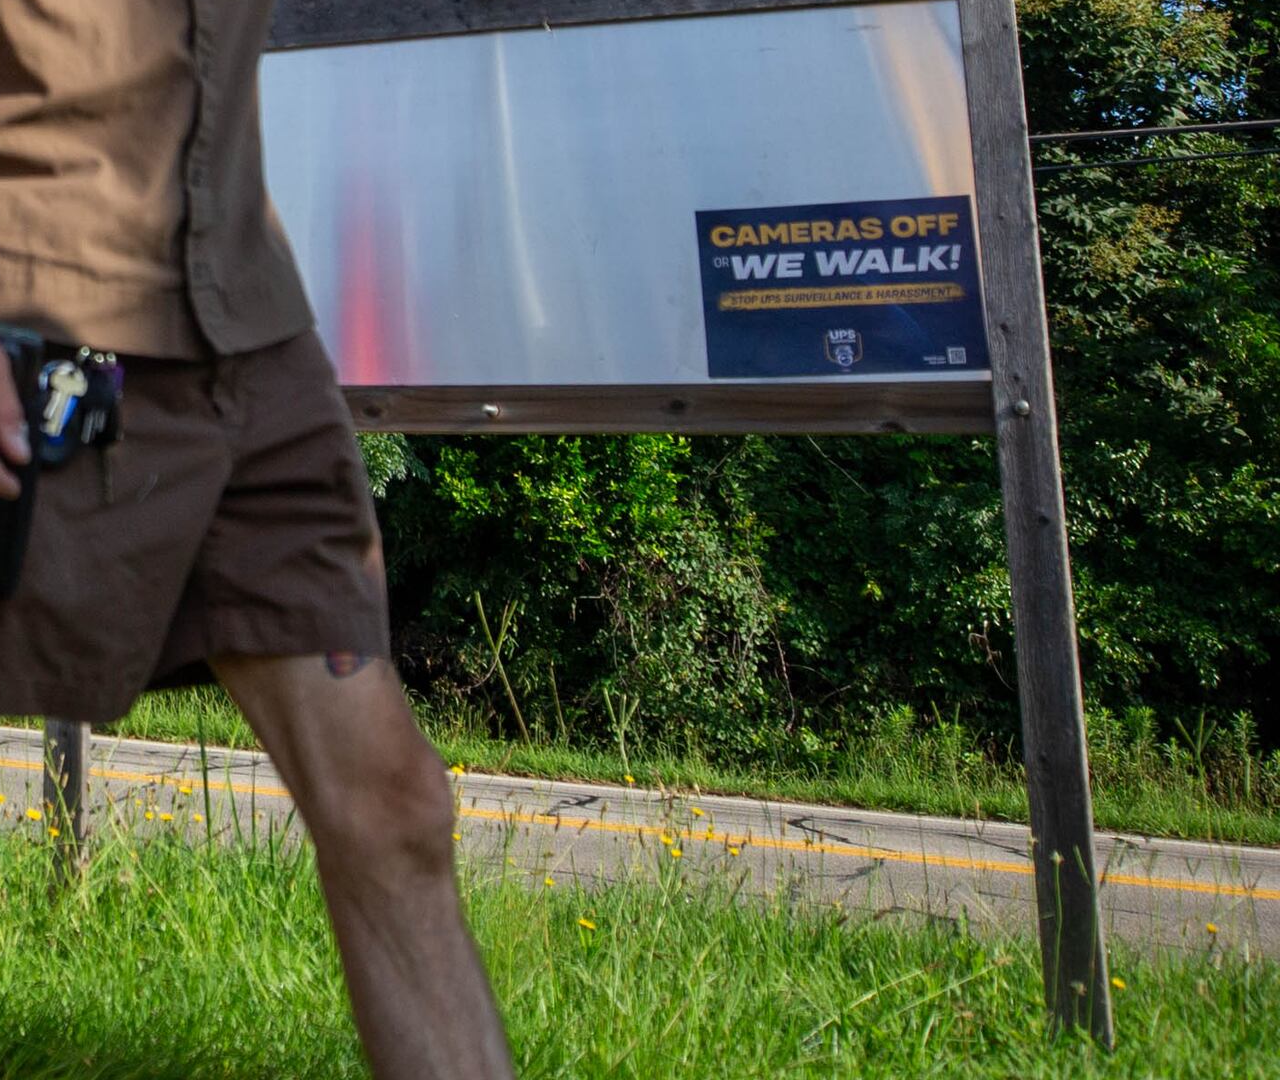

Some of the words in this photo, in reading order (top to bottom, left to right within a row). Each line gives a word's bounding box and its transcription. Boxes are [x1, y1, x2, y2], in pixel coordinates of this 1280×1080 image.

[710, 217, 884, 248] CAMERAS
[890, 213, 959, 238] OFF
[713, 256, 729, 269] OR
[730, 251, 805, 281] WE
[815, 244, 962, 278] WALK!
[731, 294, 759, 306] STOP
[760, 293, 781, 304] UPS
[784, 290, 865, 303] SURVEILLANCE
[866, 289, 874, 300] &
[876, 286, 953, 300] HARASSMENT
[829, 328, 856, 340] UPS
